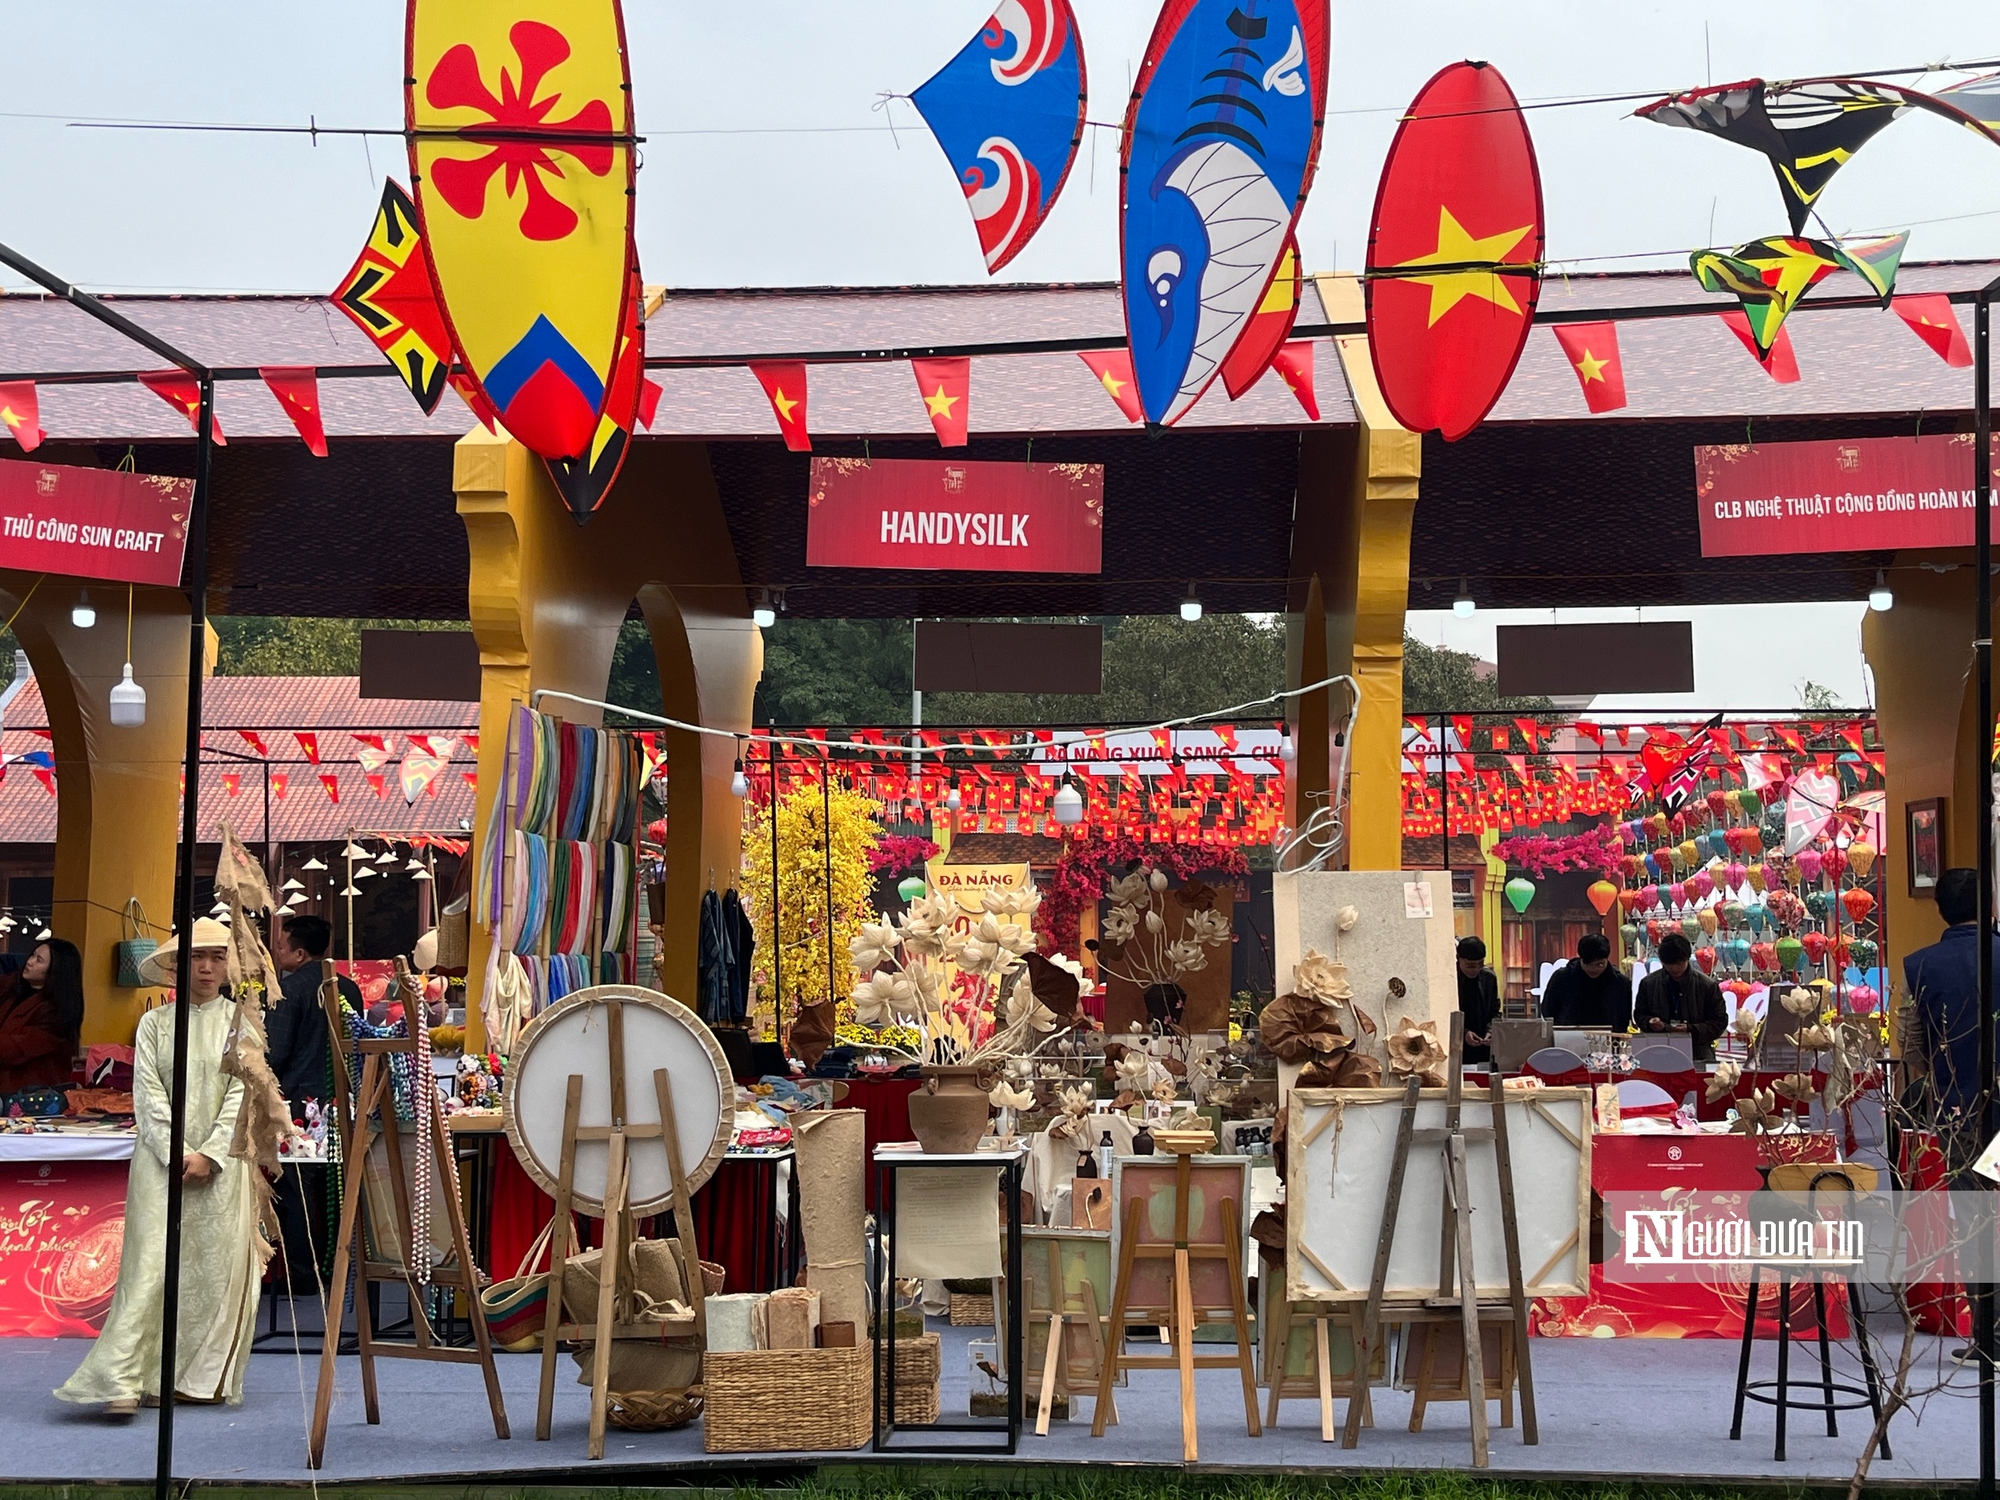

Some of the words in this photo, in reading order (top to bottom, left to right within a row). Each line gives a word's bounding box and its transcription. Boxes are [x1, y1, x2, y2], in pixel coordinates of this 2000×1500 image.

[1715, 501, 1742, 519] CLB
[1745, 496, 1783, 520] NGHỆ
[1785, 494, 1832, 518] THUẬT
[1835, 493, 1873, 516] CỘNG
[1876, 489, 1915, 511] ĐỒNG
[1919, 488, 1958, 509] HOÀN
[1961, 489, 1999, 508] KIM
[4, 513, 34, 539] THỦ
[36, 518, 78, 543] CÔNG
[80, 525, 113, 548] SUN
[114, 529, 164, 553] CRAFT
[880, 510, 1029, 547] HANDYSILK
[939, 872, 962, 886] ĐÀ
[966, 870, 1013, 886] NẴNG
